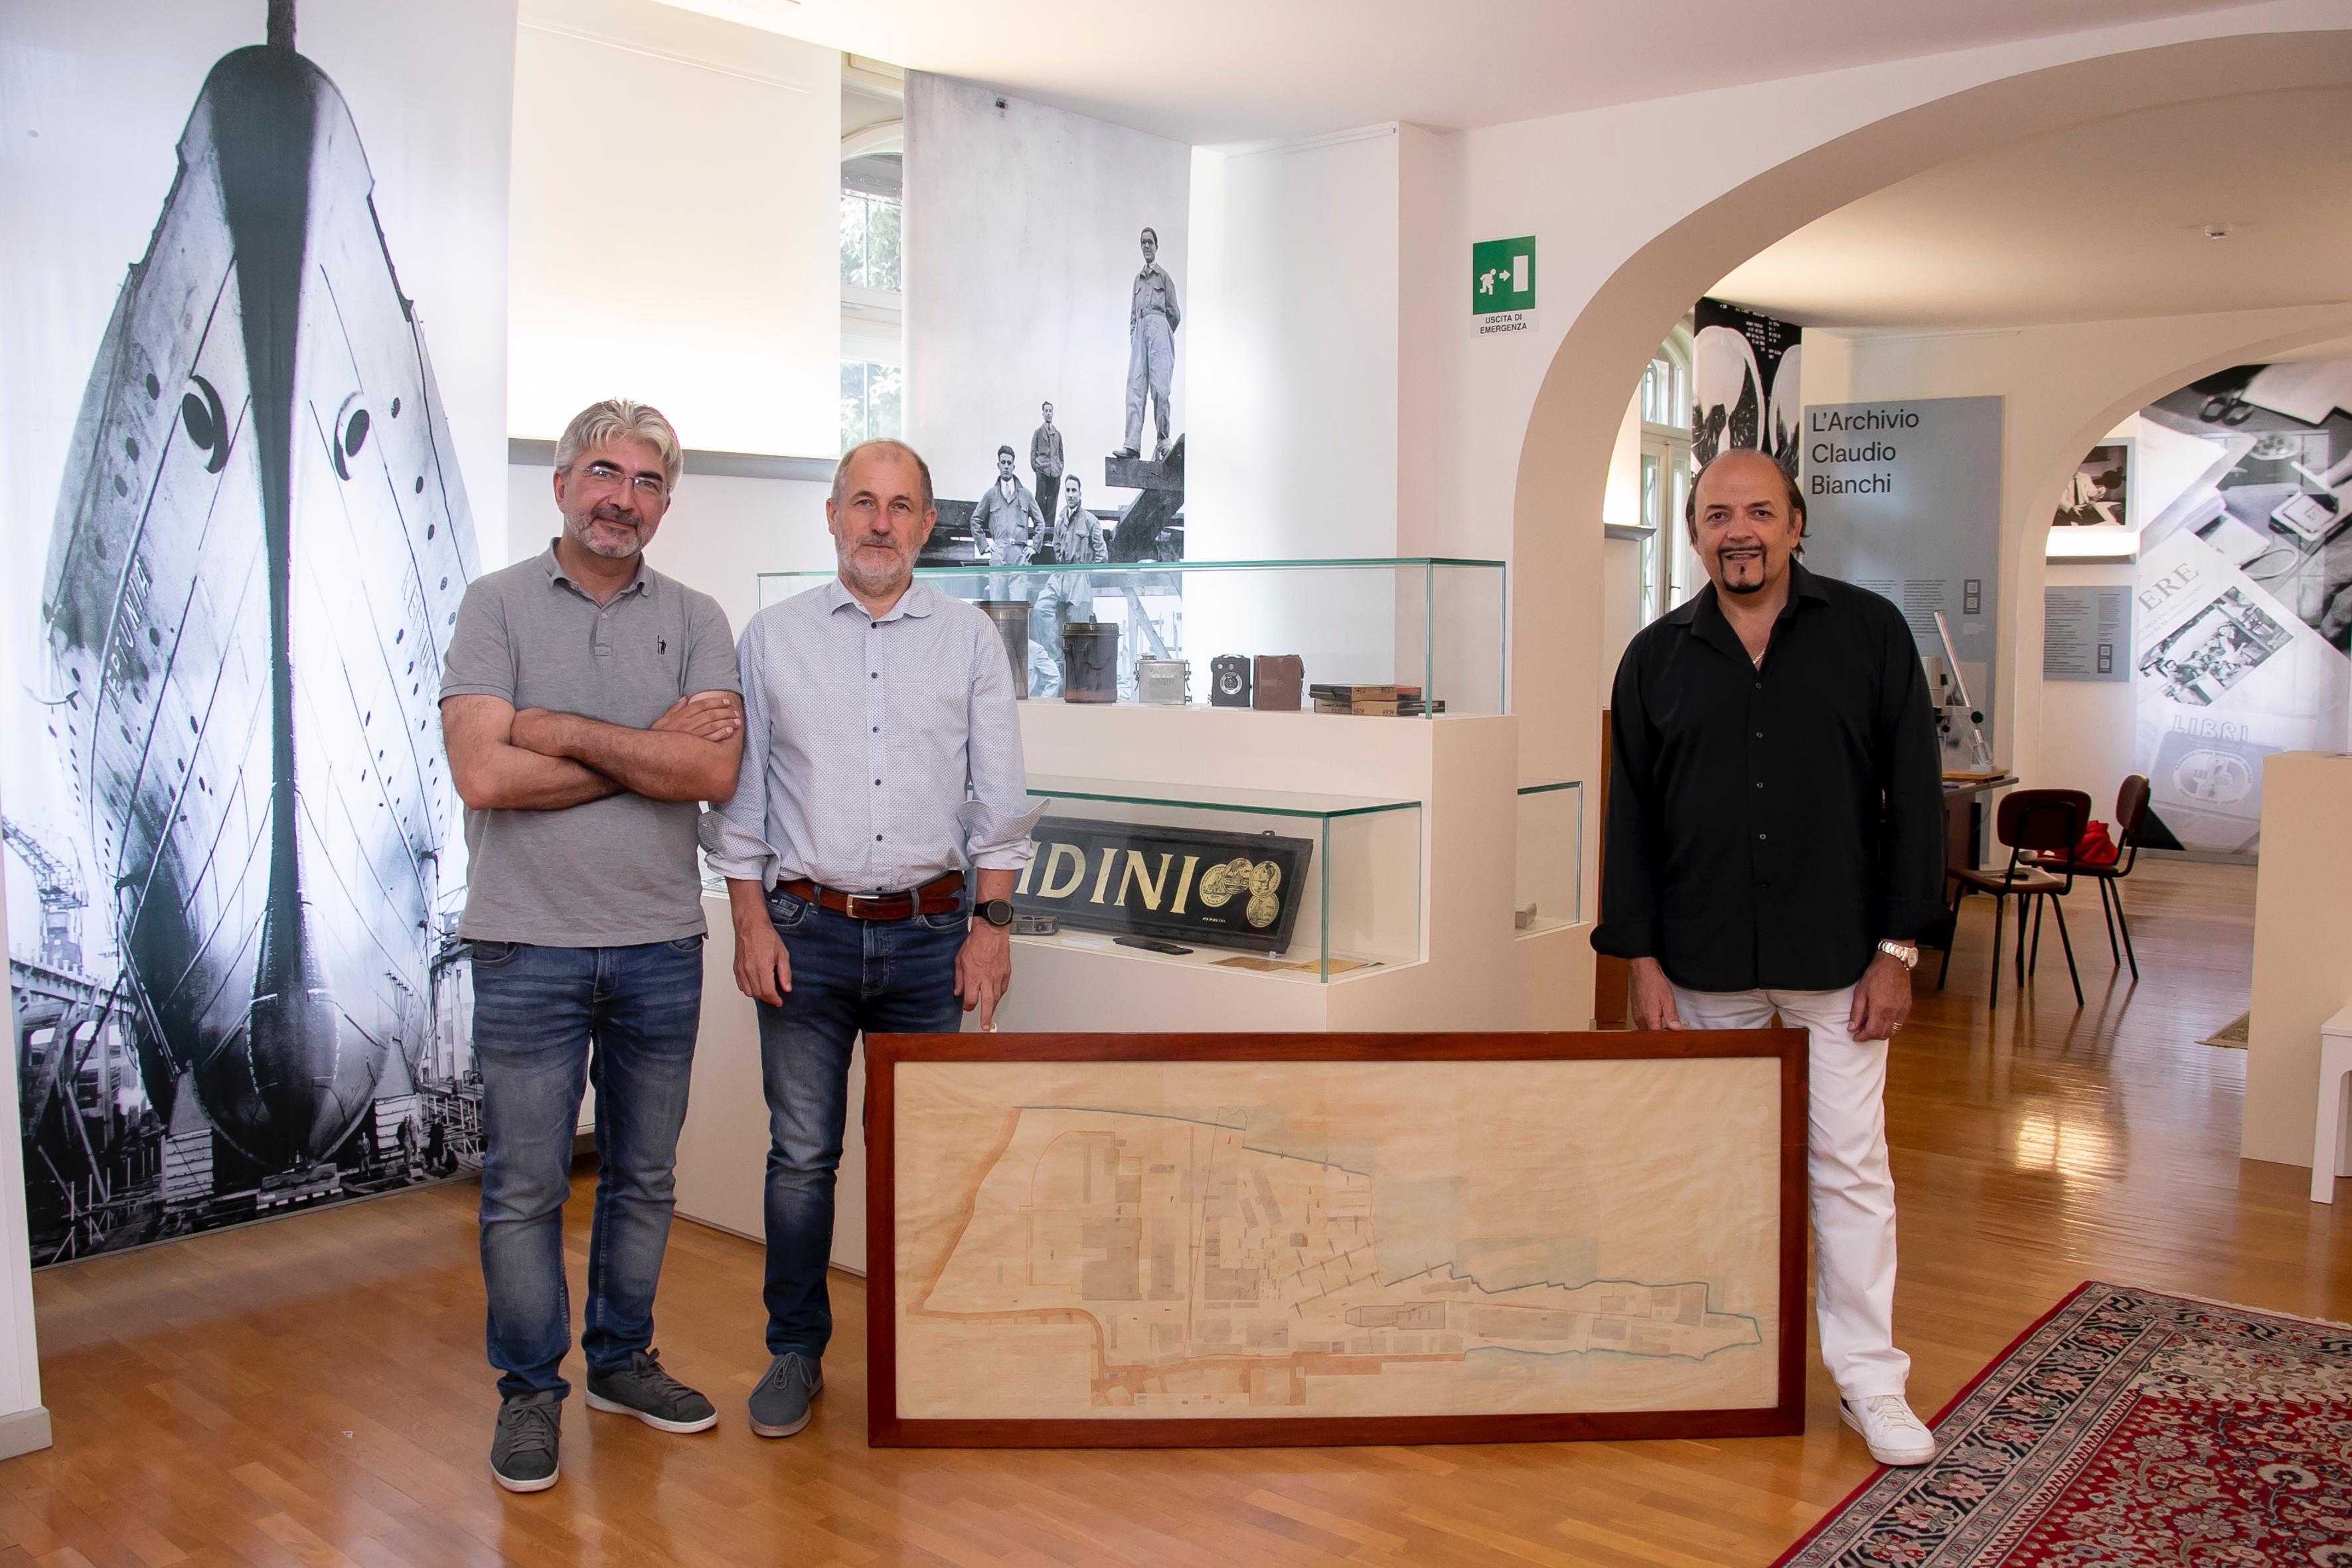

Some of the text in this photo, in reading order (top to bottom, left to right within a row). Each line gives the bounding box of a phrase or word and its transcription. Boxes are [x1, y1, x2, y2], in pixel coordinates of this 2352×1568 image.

[1480, 323, 1526, 333] EMERGENZA
[1486, 315, 1512, 323] USCITA
[1812, 441, 1896, 463] Claudio
[1812, 473, 1891, 495] Bianchi
[2172, 714, 2248, 742] LIBRI
